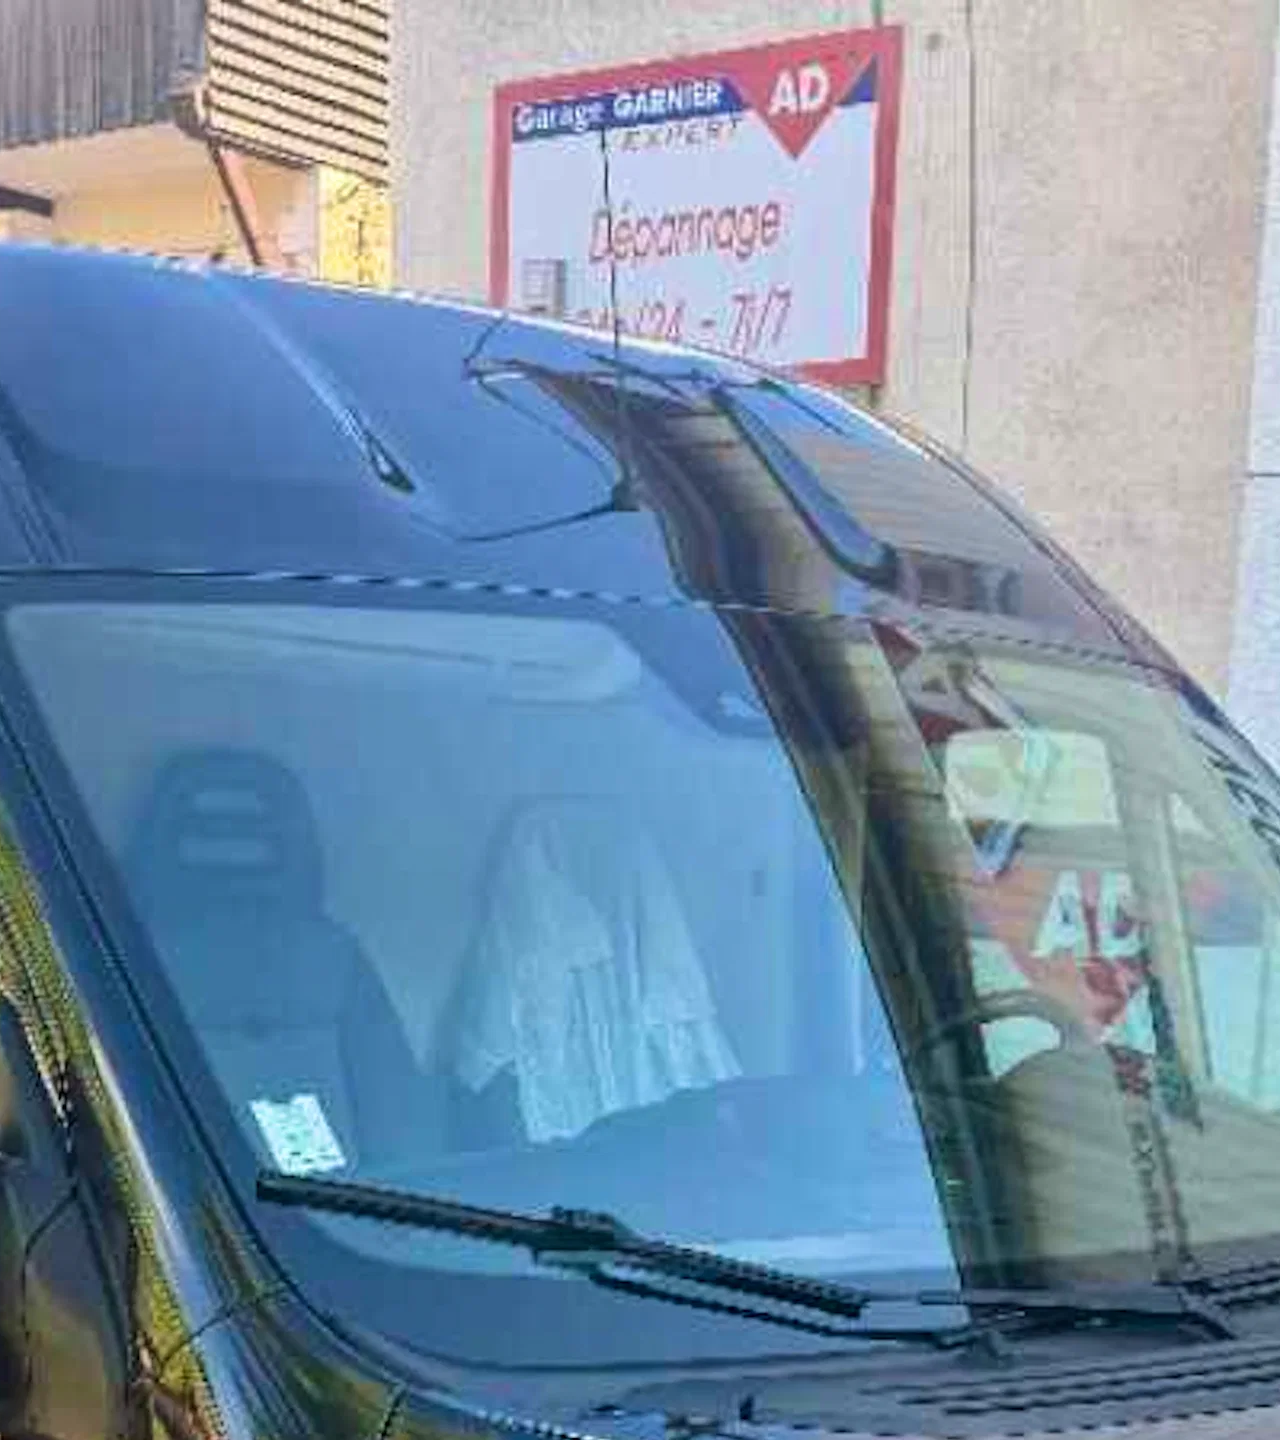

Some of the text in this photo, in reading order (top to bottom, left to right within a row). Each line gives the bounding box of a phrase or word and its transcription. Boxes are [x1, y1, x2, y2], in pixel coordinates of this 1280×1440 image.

[515, 77, 722, 134] Garage GARNIER
[769, 63, 832, 116] AD
[620, 114, 744, 153] EXPERT
